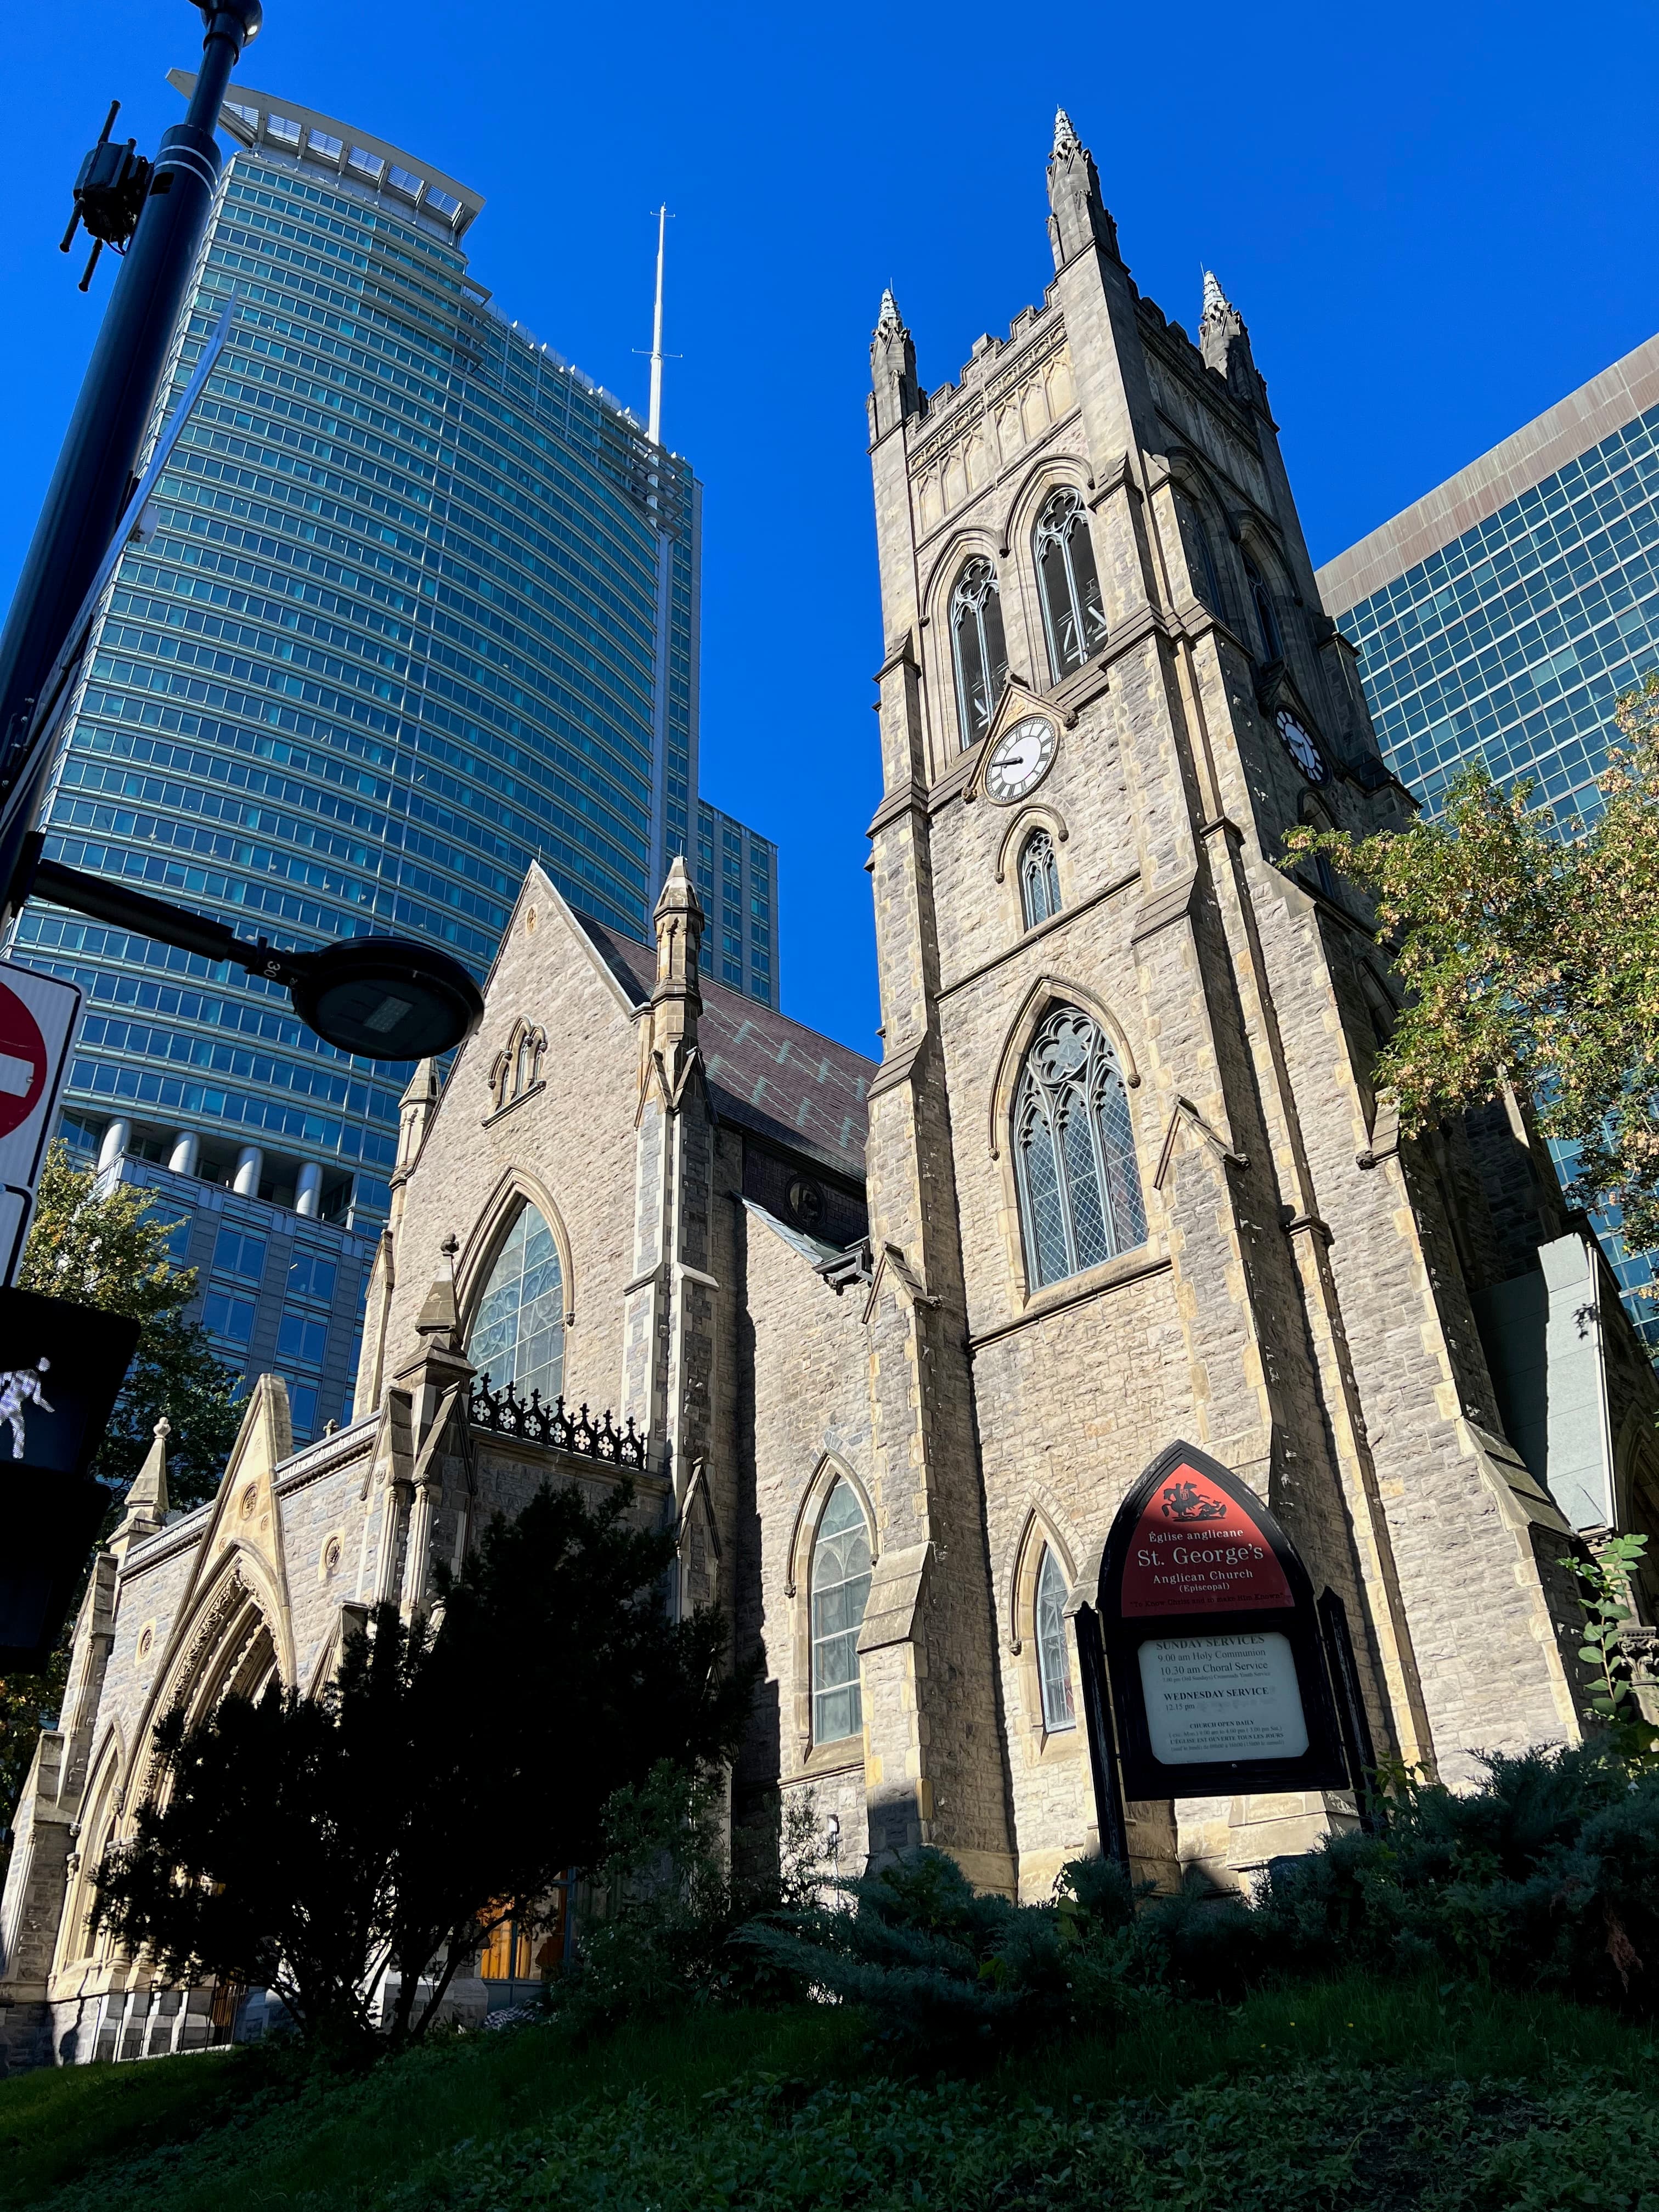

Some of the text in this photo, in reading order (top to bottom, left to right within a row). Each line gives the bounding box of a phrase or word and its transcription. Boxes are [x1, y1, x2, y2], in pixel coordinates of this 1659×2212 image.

[264, 961, 281, 977] 30
[1148, 1528, 1244, 1543] Église anglicane
[1137, 1543, 1264, 1567] St. George's
[1153, 1569, 1254, 1585] Anglican Church
[1178, 1582, 1230, 1594] (Episcopal)
[1156, 1635, 1265, 1651] SUNDAY SERVICES
[1158, 1648, 1267, 1662] 9.00 am Holy Communion
[1161, 1660, 1268, 1676] 10.30 am Choral Service
[1164, 1687, 1269, 1701] WEDNESDAY SERVICE
[1184, 1703, 1195, 1711] pm
